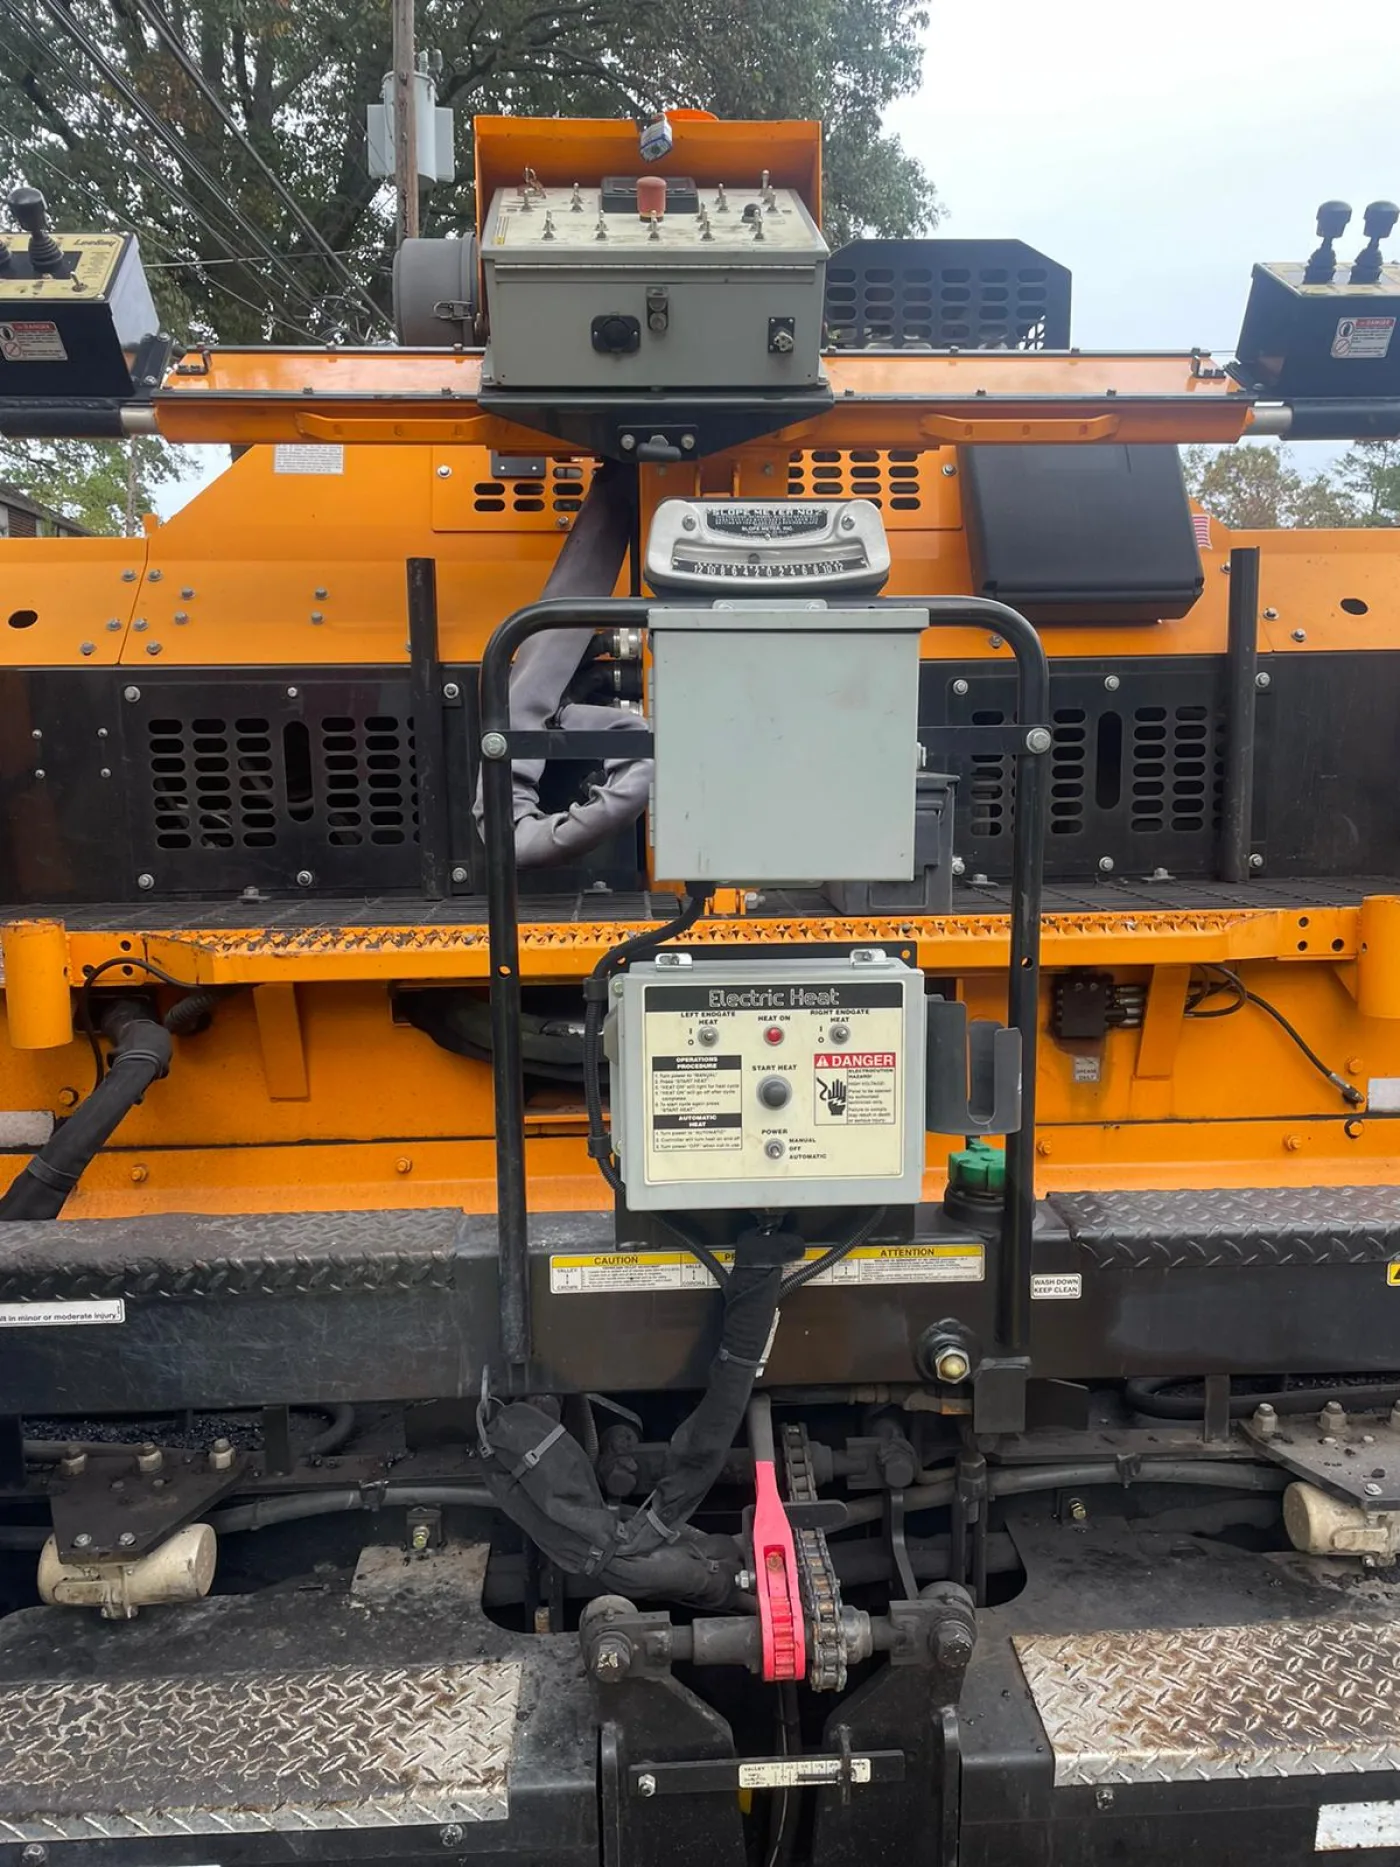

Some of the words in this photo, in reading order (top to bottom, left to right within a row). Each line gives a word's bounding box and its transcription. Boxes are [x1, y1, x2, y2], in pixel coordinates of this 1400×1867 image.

[694, 564, 703, 574] 12
[707, 566, 716, 574] 10
[743, 567, 748, 576] 4
[790, 566, 796, 576] 4
[823, 564, 832, 574] 10
[834, 562, 844, 572] 12
[708, 988, 784, 1008] Electric
[790, 988, 840, 1006] Heat
[832, 1054, 894, 1066] DANGER
[880, 1248, 934, 1257] ATTENTION
[594, 1256, 638, 1266] CAUTION
[54, 1312, 92, 1320] moderate
